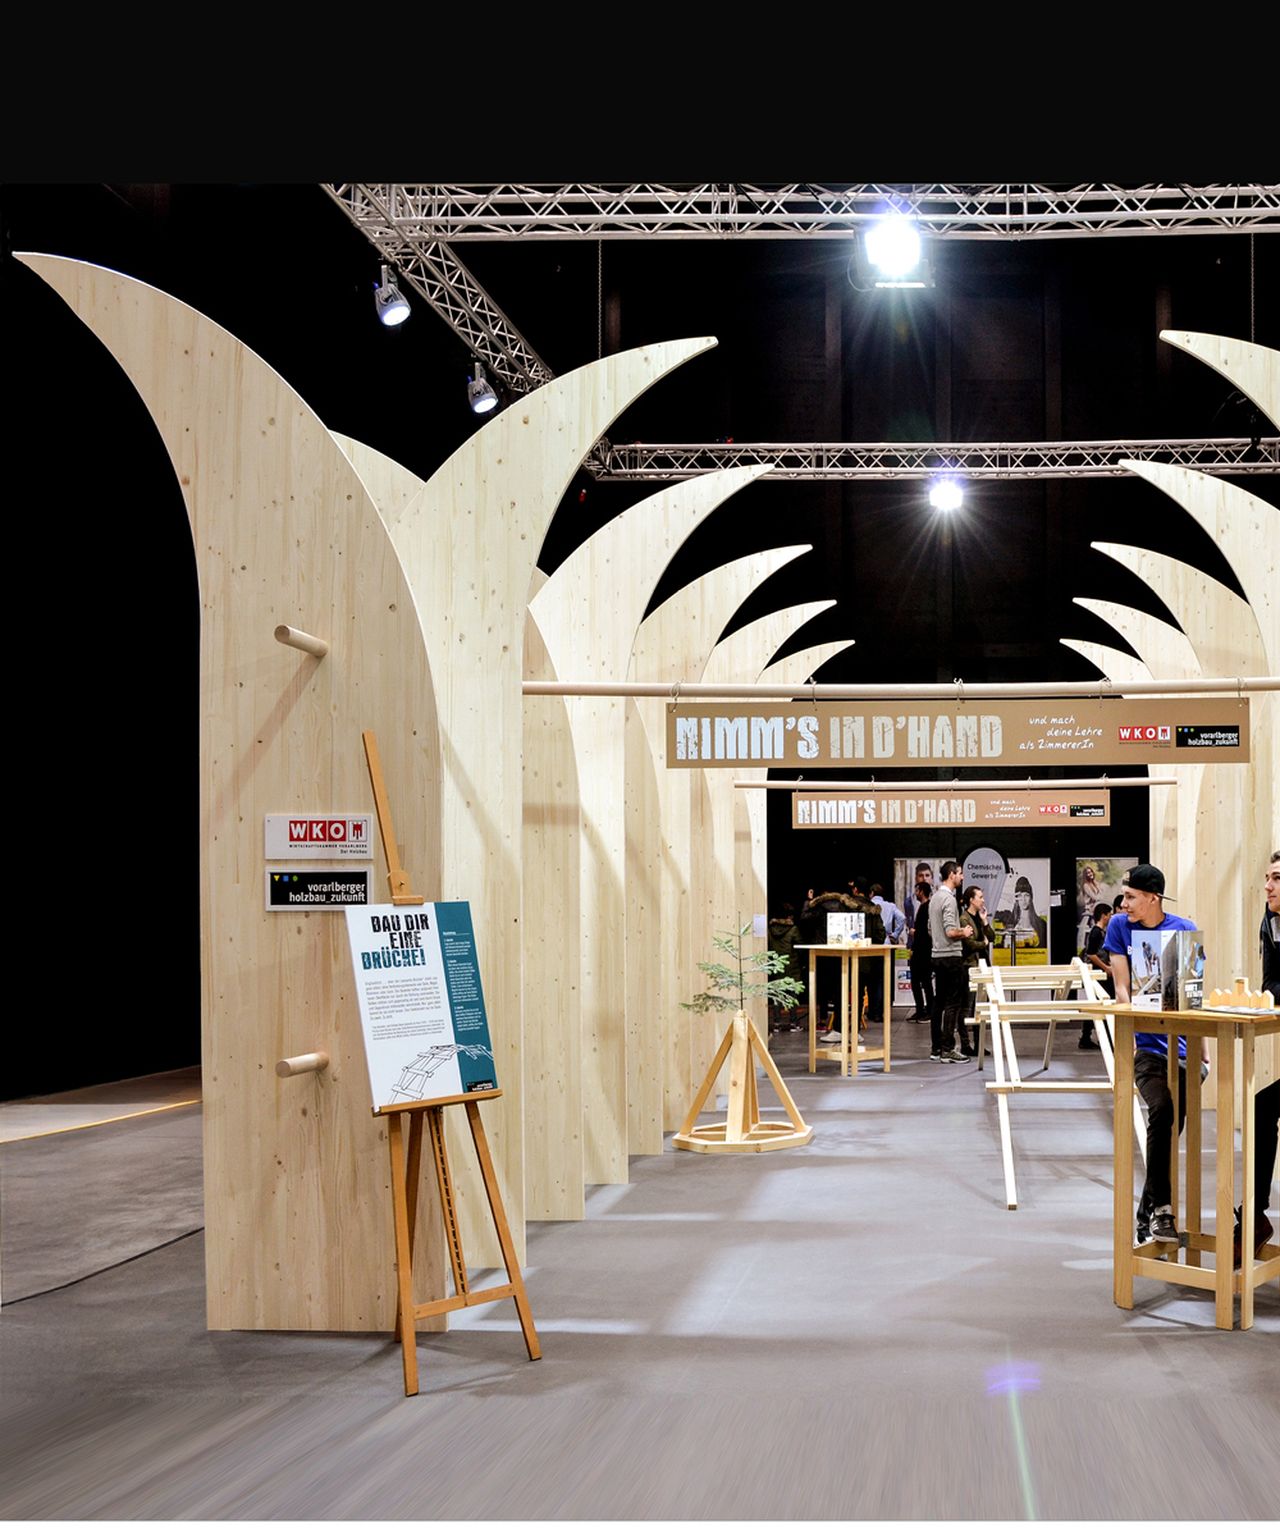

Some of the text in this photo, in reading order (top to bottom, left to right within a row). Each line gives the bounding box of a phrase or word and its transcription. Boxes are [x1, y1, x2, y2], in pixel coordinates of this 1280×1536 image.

[1029, 715, 1075, 725] und mach
[676, 715, 1002, 760] NIMM'S IN D'HAND
[1047, 726, 1103, 737] deine Lehre
[1119, 727, 1158, 740] WKO
[1200, 732, 1238, 740] vorarlberger
[1019, 742, 1035, 750] als
[798, 799, 976, 824] NIMM'S IN D'HAND
[289, 821, 346, 841] WKO
[967, 863, 1002, 871] Chemisches
[971, 872, 998, 880] Gewerbe
[308, 881, 365, 894] vorarlberger
[289, 892, 365, 904] holzbau_zukunft
[371, 913, 430, 933] BAU DIR
[389, 931, 422, 950] EINE
